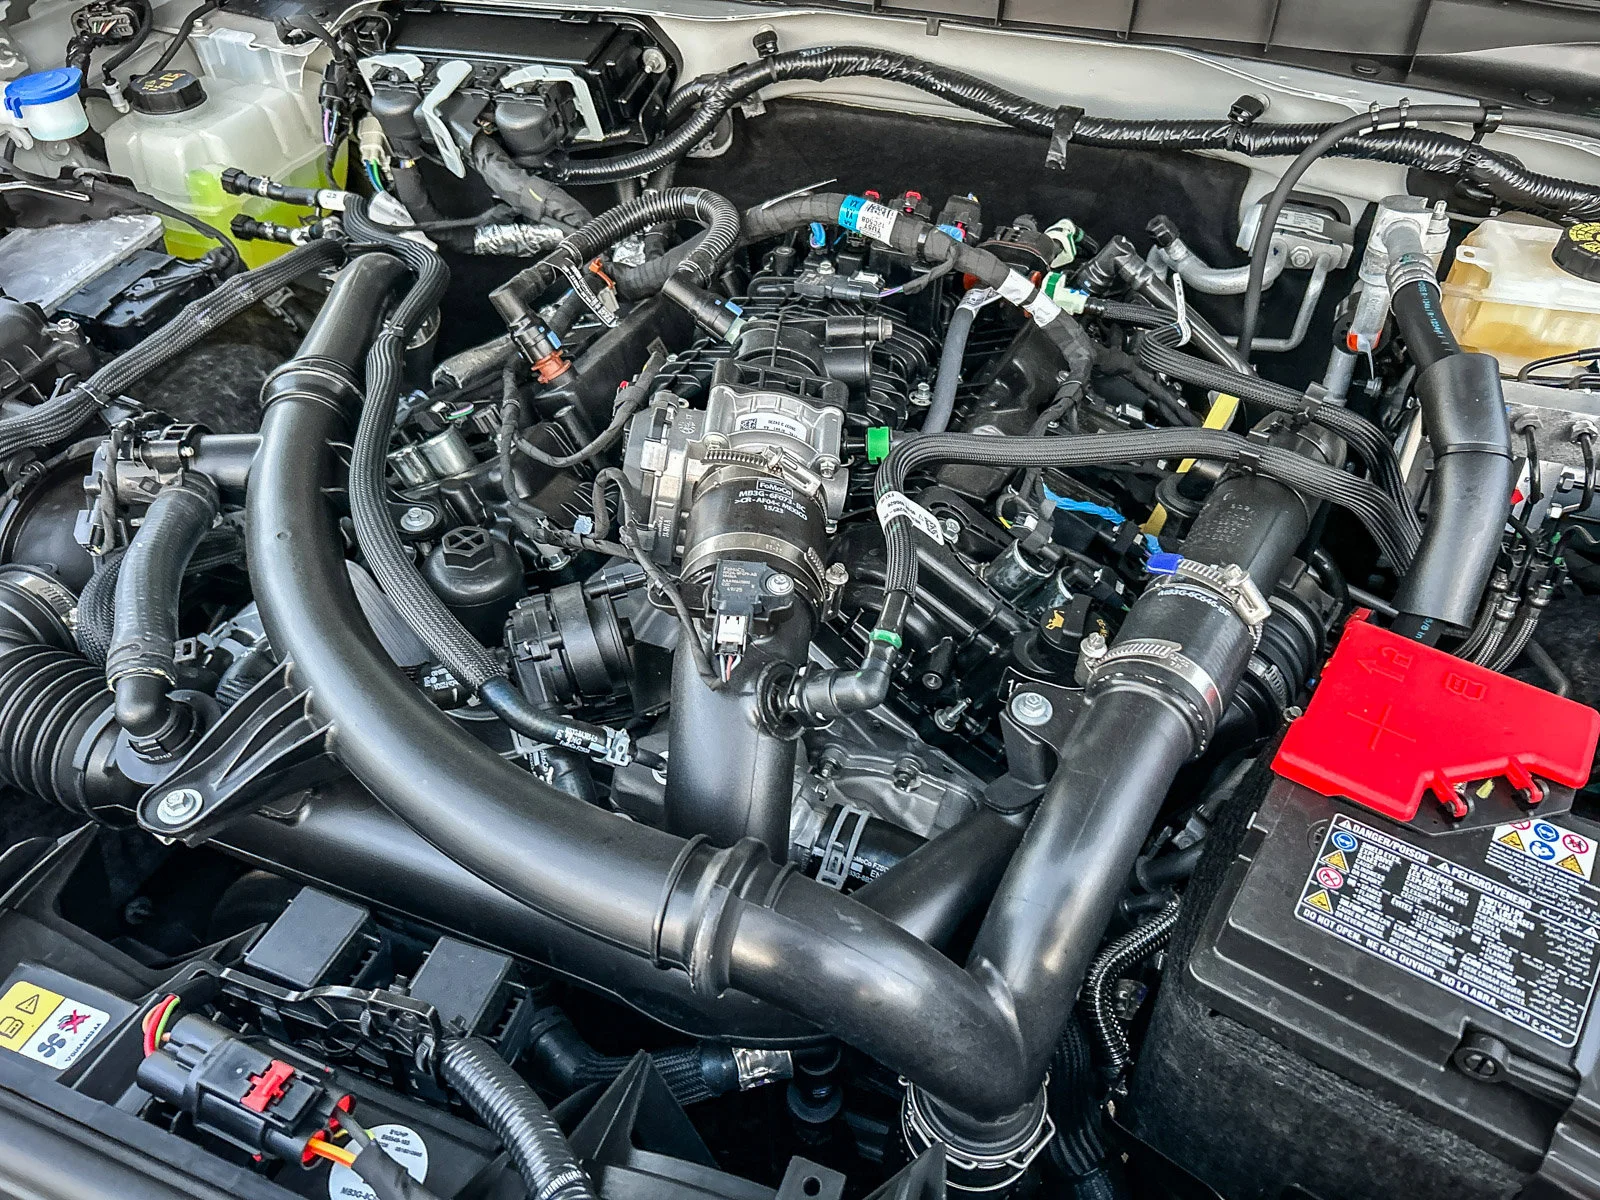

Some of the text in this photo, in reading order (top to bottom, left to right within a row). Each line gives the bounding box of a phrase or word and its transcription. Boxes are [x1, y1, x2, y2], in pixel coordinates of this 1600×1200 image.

[759, 482, 792, 496] FoMoCo
[763, 504, 784, 515] 15/23
[1351, 823, 1429, 863] DANGER/POISON
[1450, 866, 1532, 909] PELIGRO/VENENO
[1302, 907, 1317, 920] DO
[1316, 914, 1336, 929] NOT
[1365, 938, 1380, 951] NE
[1378, 944, 1398, 959] PAS
[1440, 973, 1455, 987] NO
[1455, 981, 1469, 993] LA
